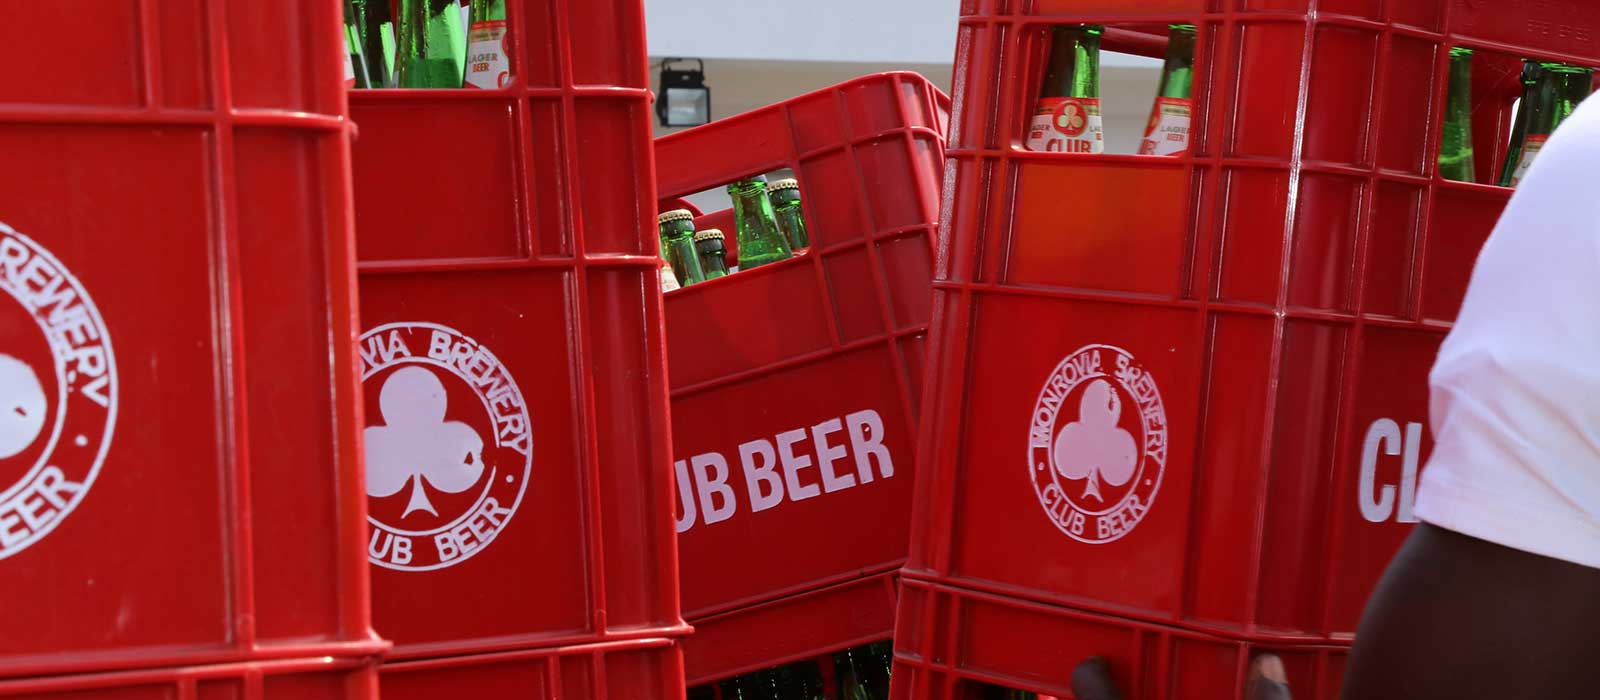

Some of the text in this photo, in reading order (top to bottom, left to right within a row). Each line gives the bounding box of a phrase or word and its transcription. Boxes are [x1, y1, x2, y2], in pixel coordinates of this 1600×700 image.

[0, 235, 110, 408] REWERY
[428, 330, 528, 455] BREWERY
[1033, 350, 1166, 465] MONROVIA BREWERY
[0, 465, 85, 547] EER
[674, 409, 894, 533] UB BEER
[1043, 483, 1146, 539] CLUB BEER
[1358, 417, 1422, 523] CL
[368, 497, 510, 565] UB BEER
